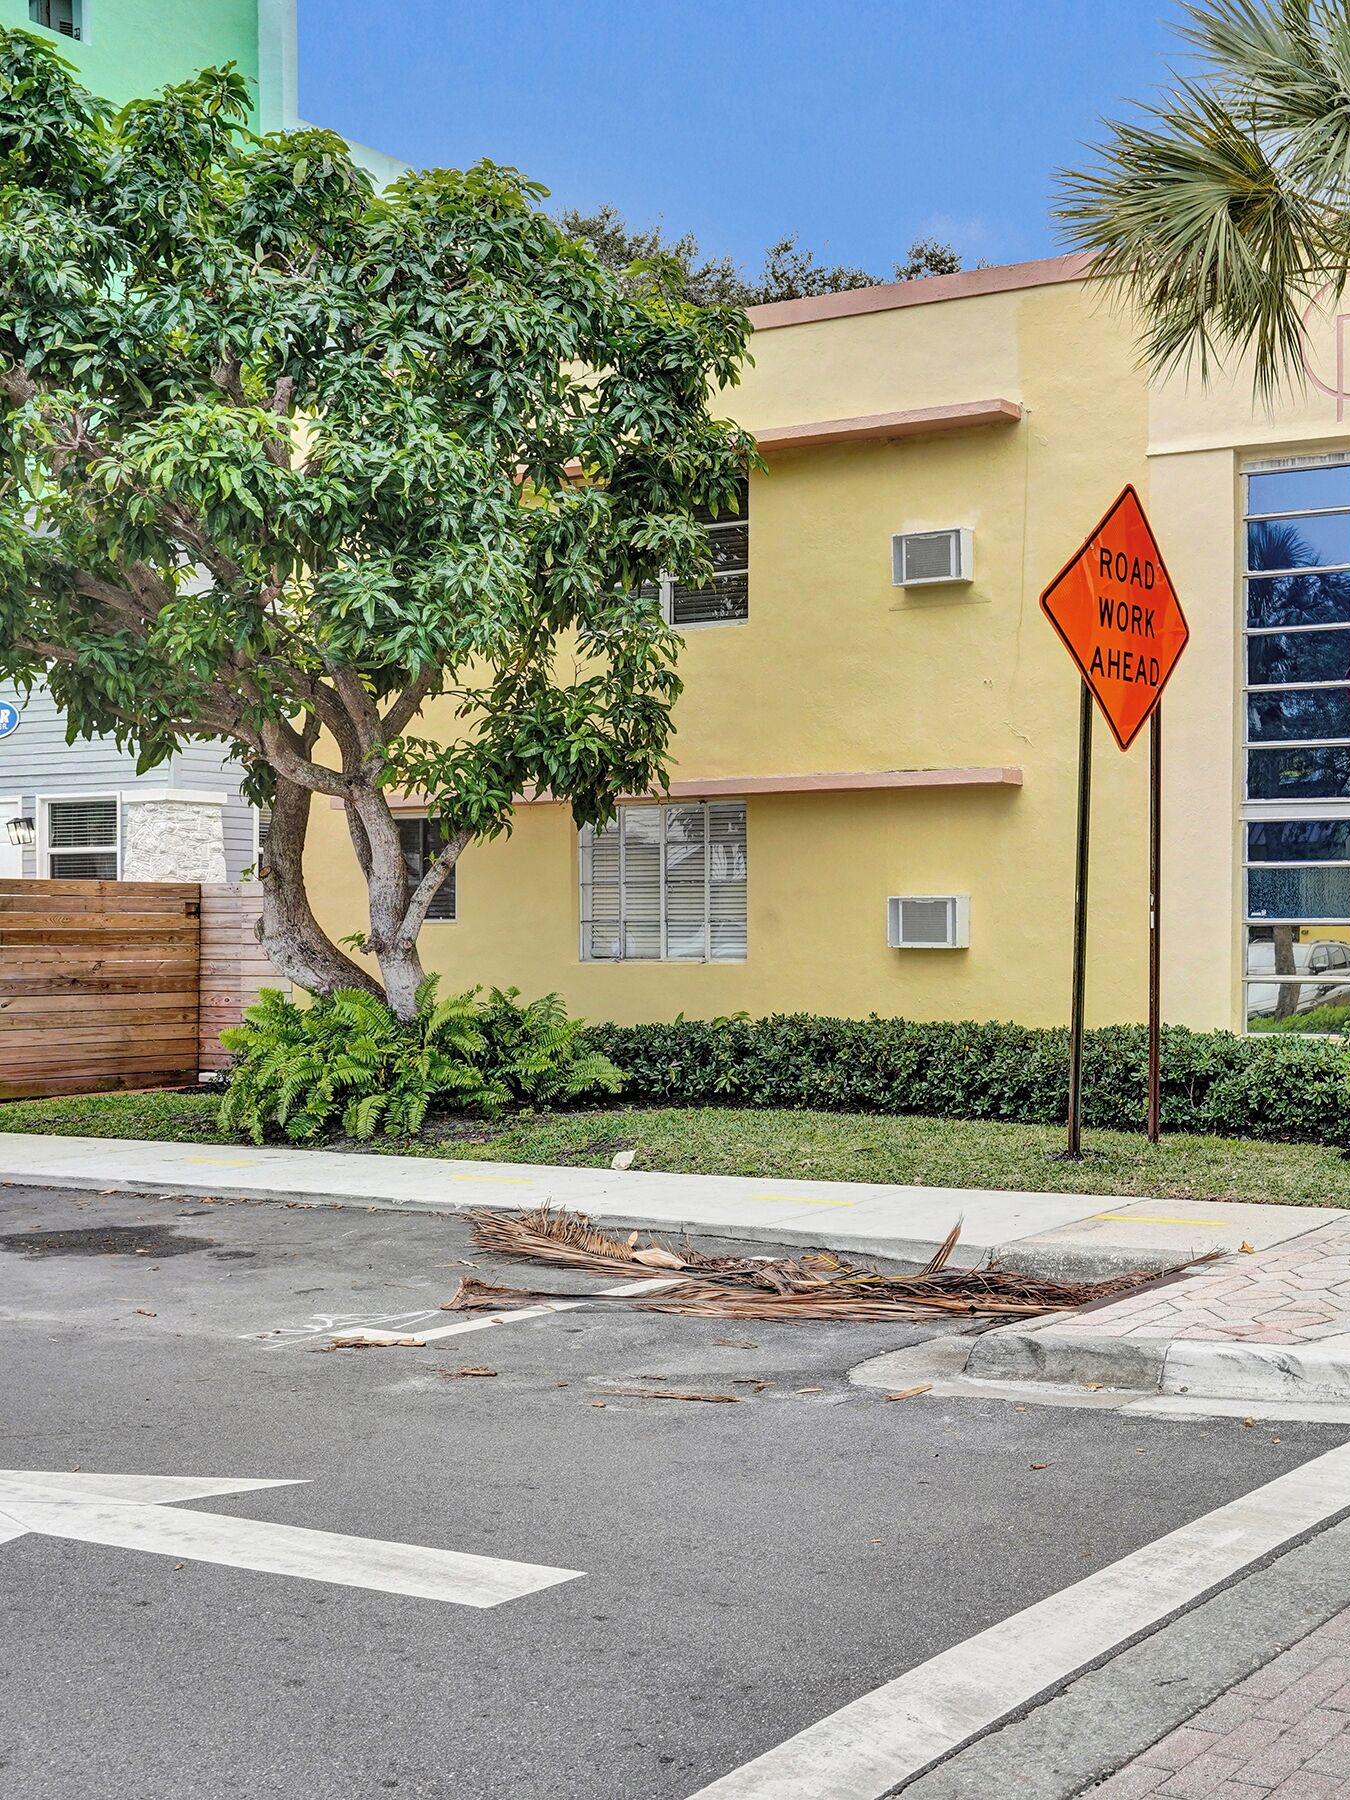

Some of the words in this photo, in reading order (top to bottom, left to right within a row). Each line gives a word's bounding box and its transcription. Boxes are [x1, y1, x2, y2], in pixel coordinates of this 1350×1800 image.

[1099, 547, 1155, 590] ROAD
[1098, 596, 1156, 639] WORK
[1090, 646, 1160, 687] AHEAD
